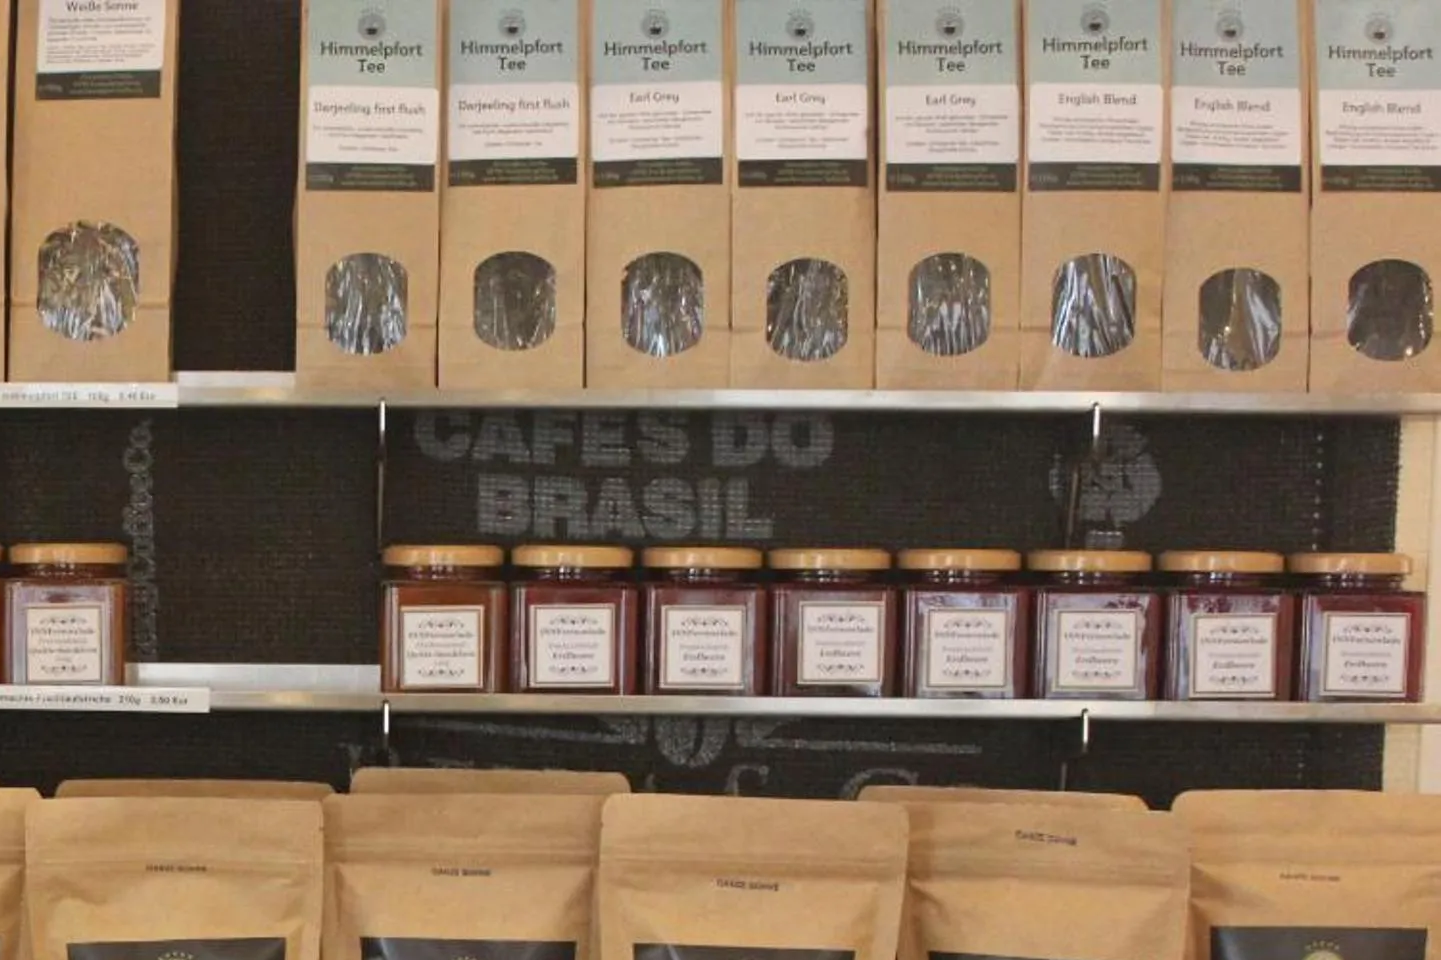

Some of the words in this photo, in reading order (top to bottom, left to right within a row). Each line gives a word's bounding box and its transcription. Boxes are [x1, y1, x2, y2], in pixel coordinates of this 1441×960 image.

[104, 1, 138, 12] Sonne
[319, 40, 423, 58] Himmelpfort
[460, 38, 564, 56] Himmelpfort
[603, 39, 707, 56] Himmelpfort
[748, 40, 854, 57] Himmelpfort
[898, 39, 1004, 56] Himmelpfort
[1042, 36, 1149, 52] Himmelpfort
[1180, 42, 1284, 60] Himmelpfort
[1080, 54, 1111, 70] Tee
[1327, 45, 1434, 63] Himmelpfort
[357, 58, 386, 73] Tee
[498, 56, 527, 71] Tee
[641, 57, 670, 71] Tee
[786, 58, 816, 73] Tee
[935, 57, 966, 73] Tee
[1217, 60, 1247, 77] Tee
[1365, 62, 1397, 78] Tee
[629, 92, 651, 103] Earl
[775, 93, 798, 104] Earl
[925, 94, 947, 105] Earl
[1058, 93, 1101, 105] English
[1194, 97, 1235, 112] English
[313, 102, 371, 116] Darjeeling
[374, 104, 396, 115] first
[398, 104, 427, 115] flush
[458, 99, 516, 113] Darjeeling
[518, 99, 541, 110] first
[1342, 101, 1383, 114] English
[709, 409, 835, 468] DO
[477, 473, 775, 540] BRASIL
